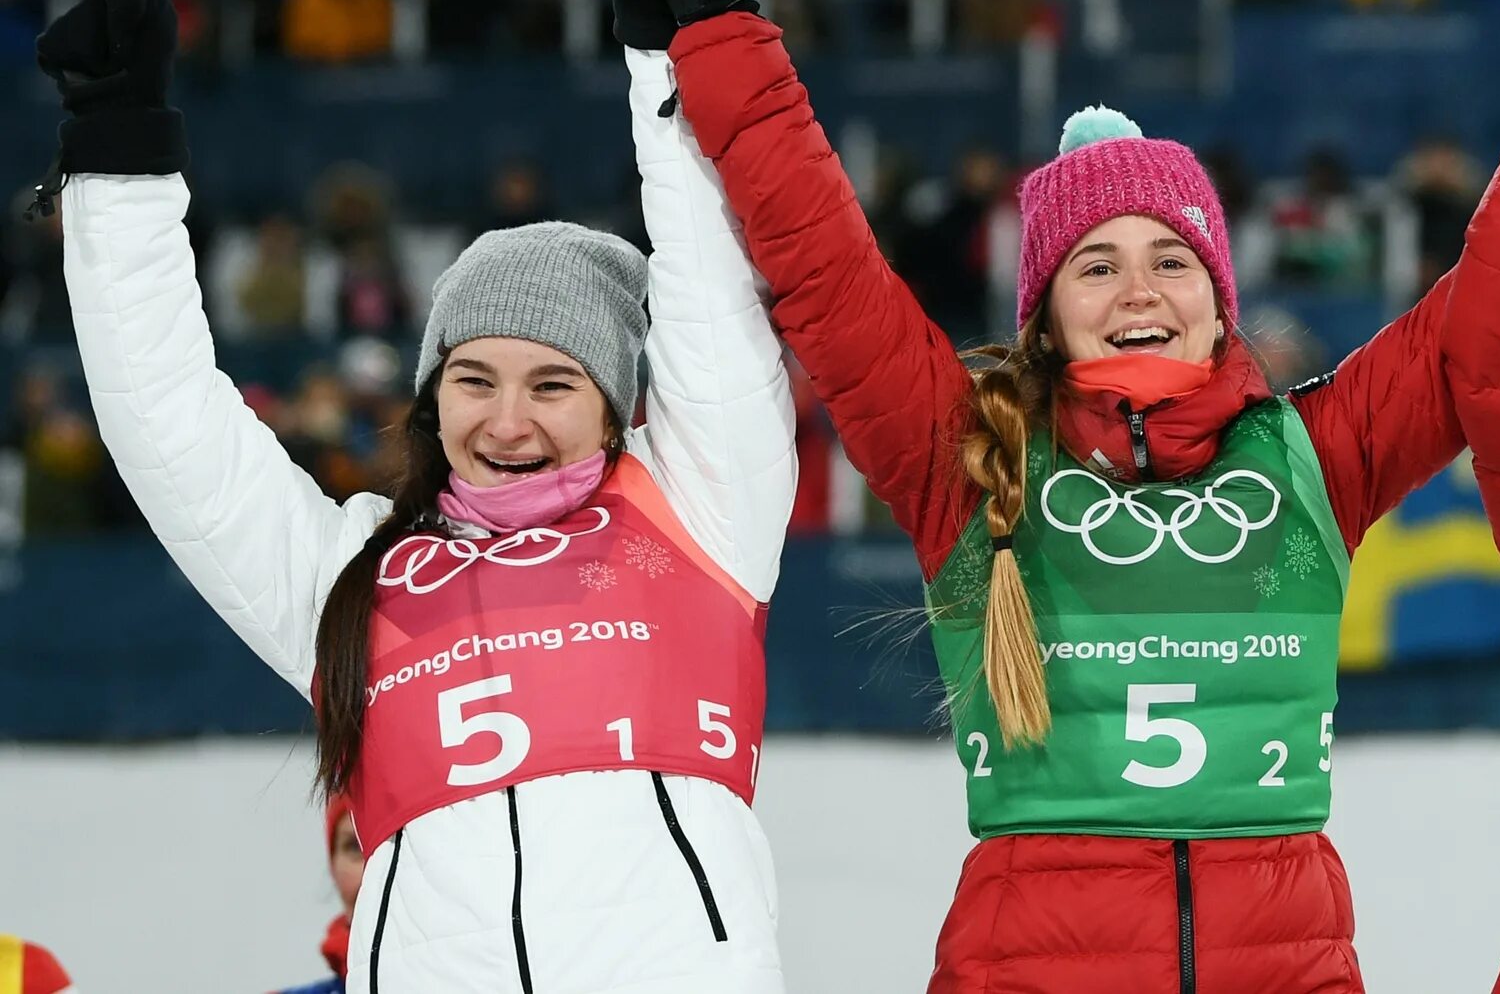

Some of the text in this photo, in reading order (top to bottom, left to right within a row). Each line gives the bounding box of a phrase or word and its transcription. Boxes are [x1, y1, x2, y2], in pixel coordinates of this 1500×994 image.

[364, 622, 564, 708] yeongChang
[1038, 635, 1239, 666] yeongChang
[437, 674, 531, 787] 5
[605, 717, 636, 762] 1
[697, 698, 737, 761] 5
[966, 731, 993, 778] 2
[1121, 683, 1208, 788] 5
[1257, 740, 1289, 787] 2
